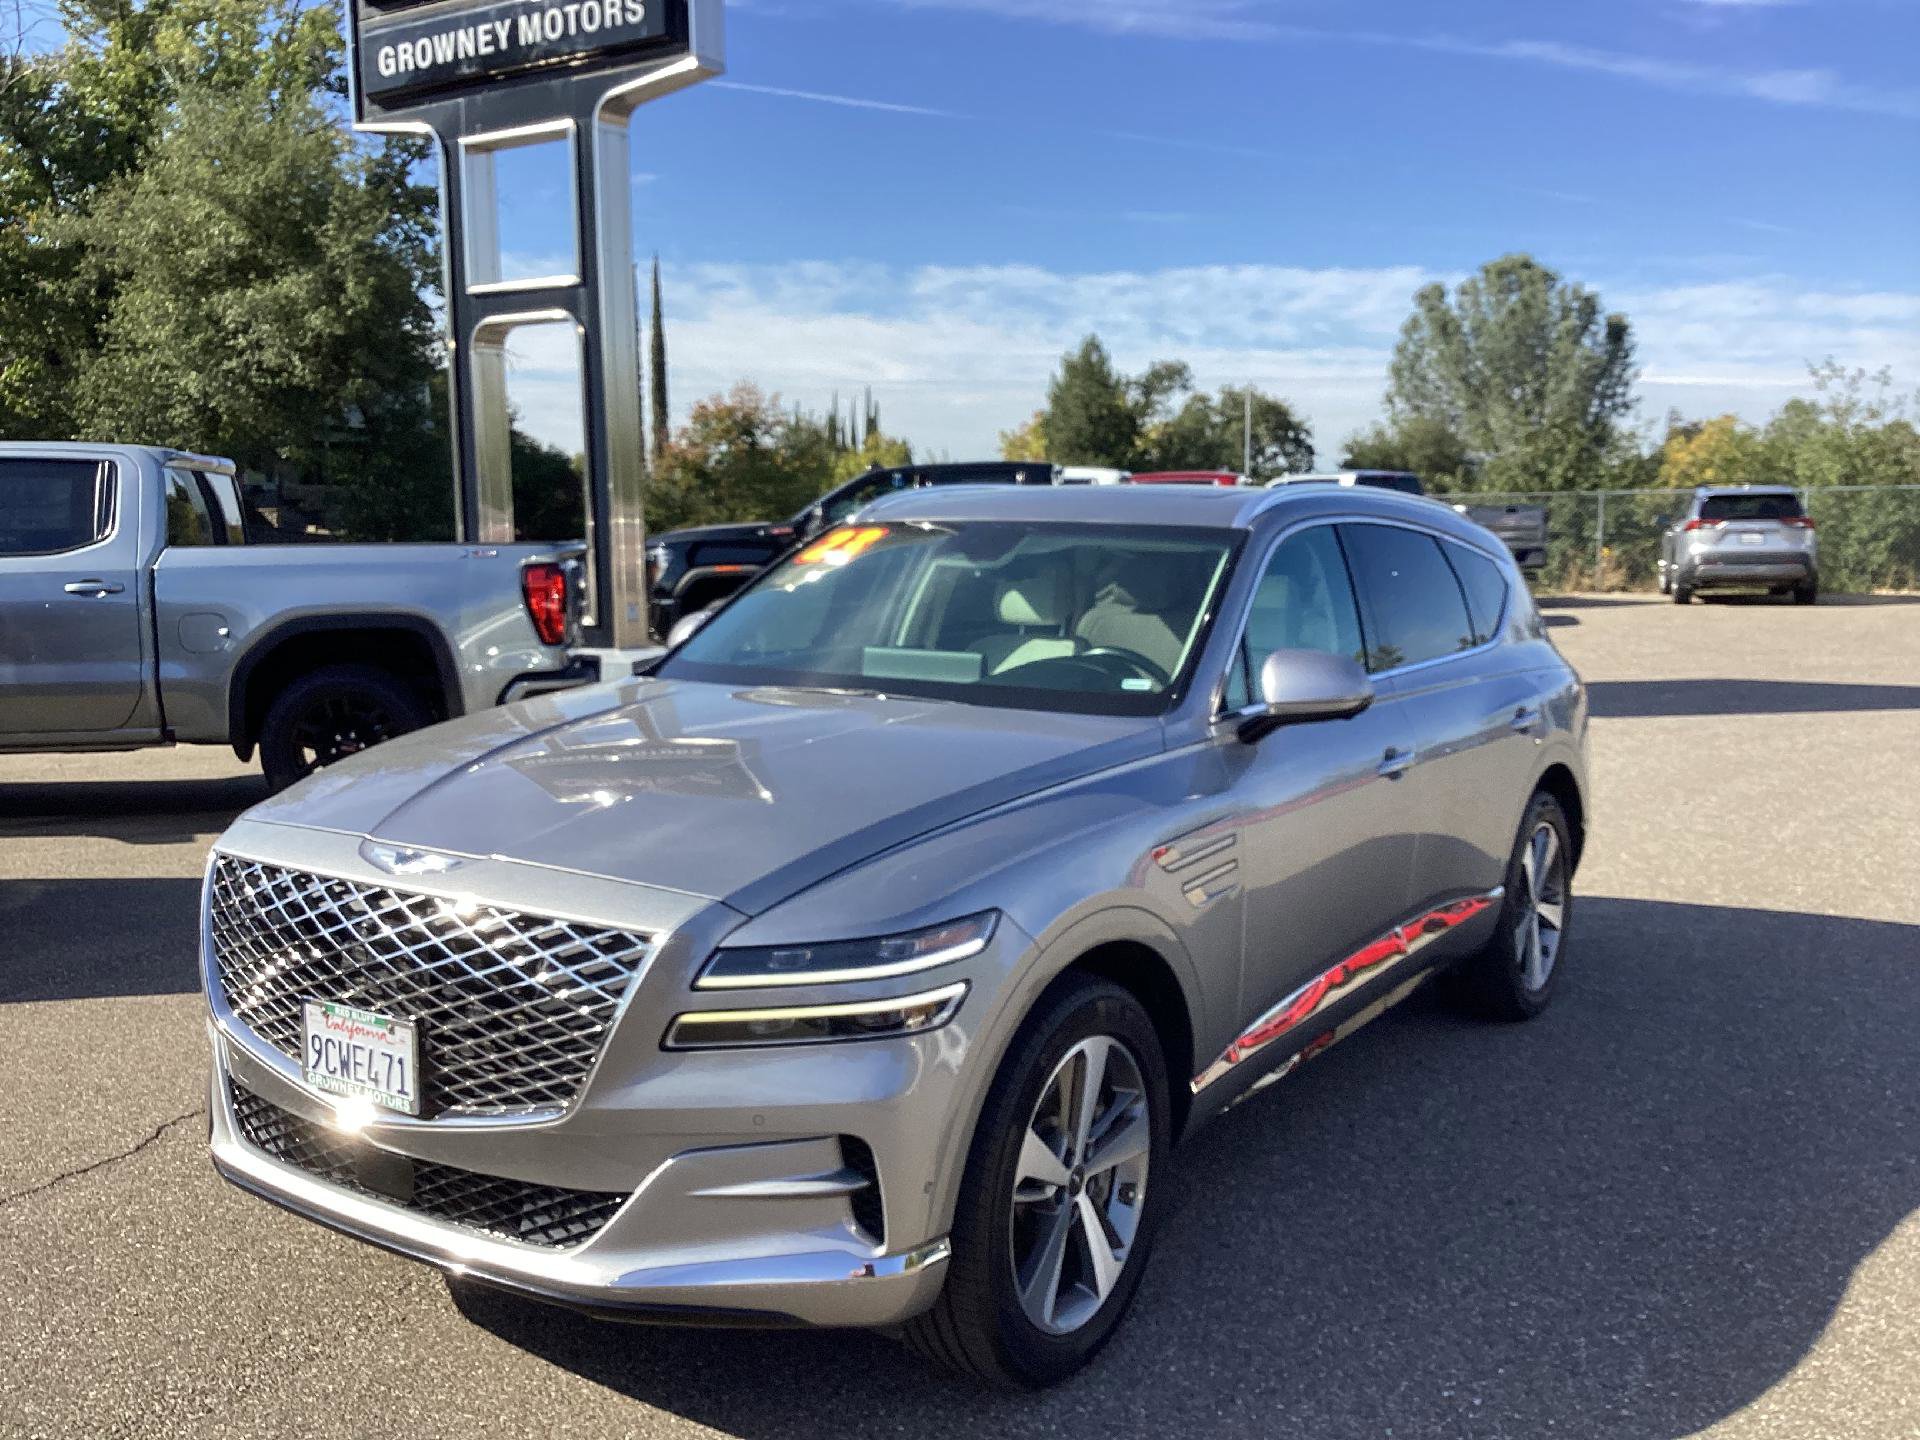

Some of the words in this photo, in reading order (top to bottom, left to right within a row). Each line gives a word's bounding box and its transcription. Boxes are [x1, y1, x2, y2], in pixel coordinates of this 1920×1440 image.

[377, 18, 510, 78] GROWNEY
[518, 0, 646, 46] MOTORS
[323, 1014, 395, 1045] California
[310, 1033, 410, 1097] 9CWE471
[307, 1071, 361, 1098] GROWNEY
[363, 1086, 411, 1112] MOTORS
